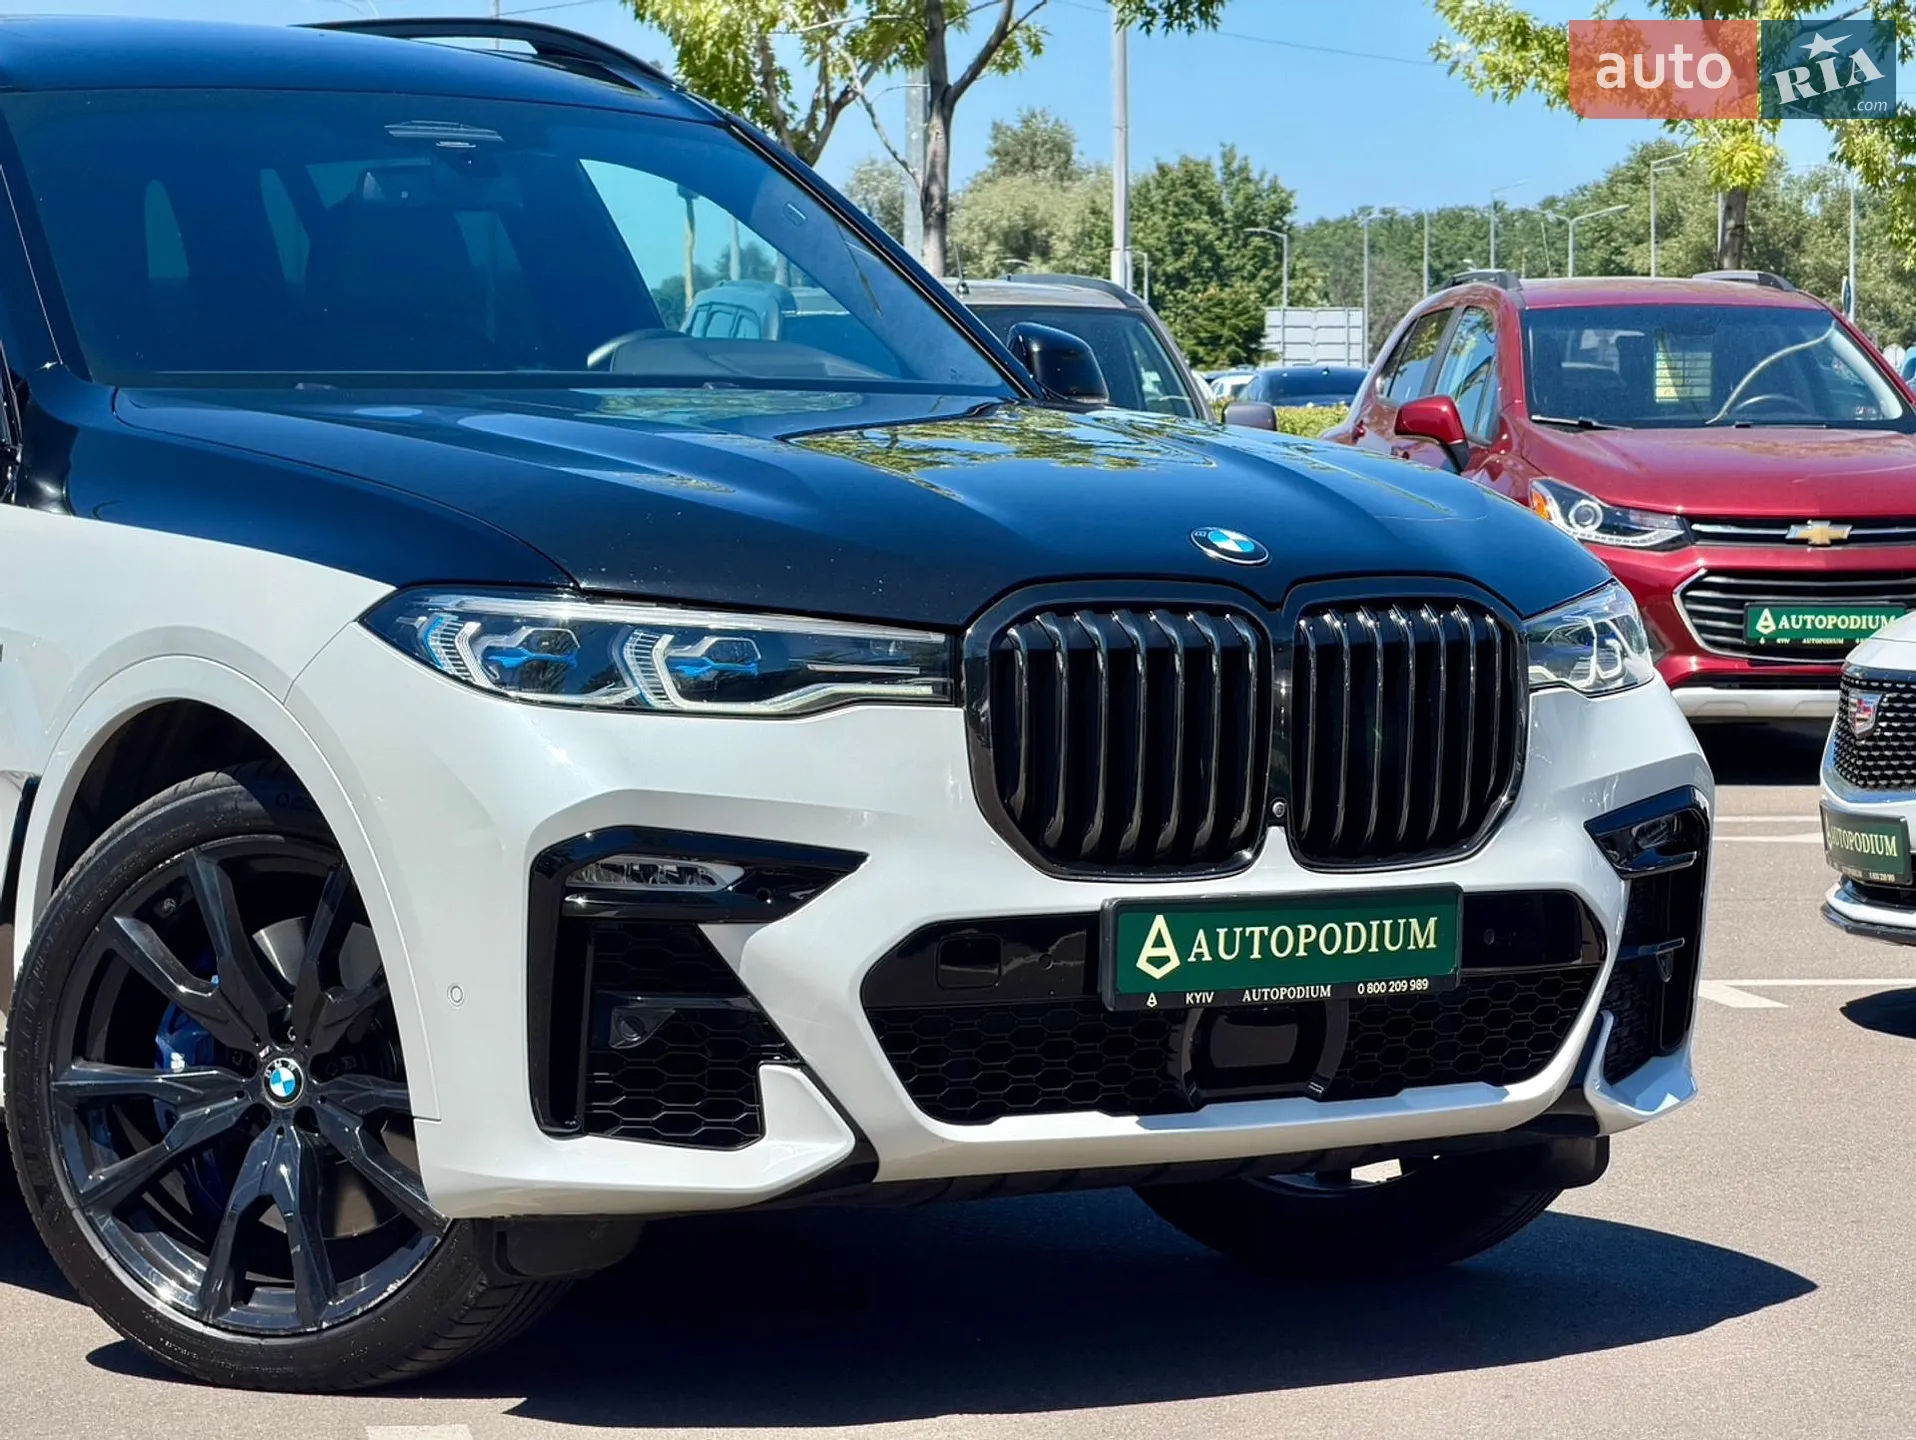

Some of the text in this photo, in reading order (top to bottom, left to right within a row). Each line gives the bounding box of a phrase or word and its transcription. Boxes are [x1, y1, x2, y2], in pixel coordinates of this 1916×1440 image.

[1187, 916, 1438, 963] AUTOPODIUM
[1185, 977, 1430, 1005] KYIV AUTOPODIUM 0 800 209 989
